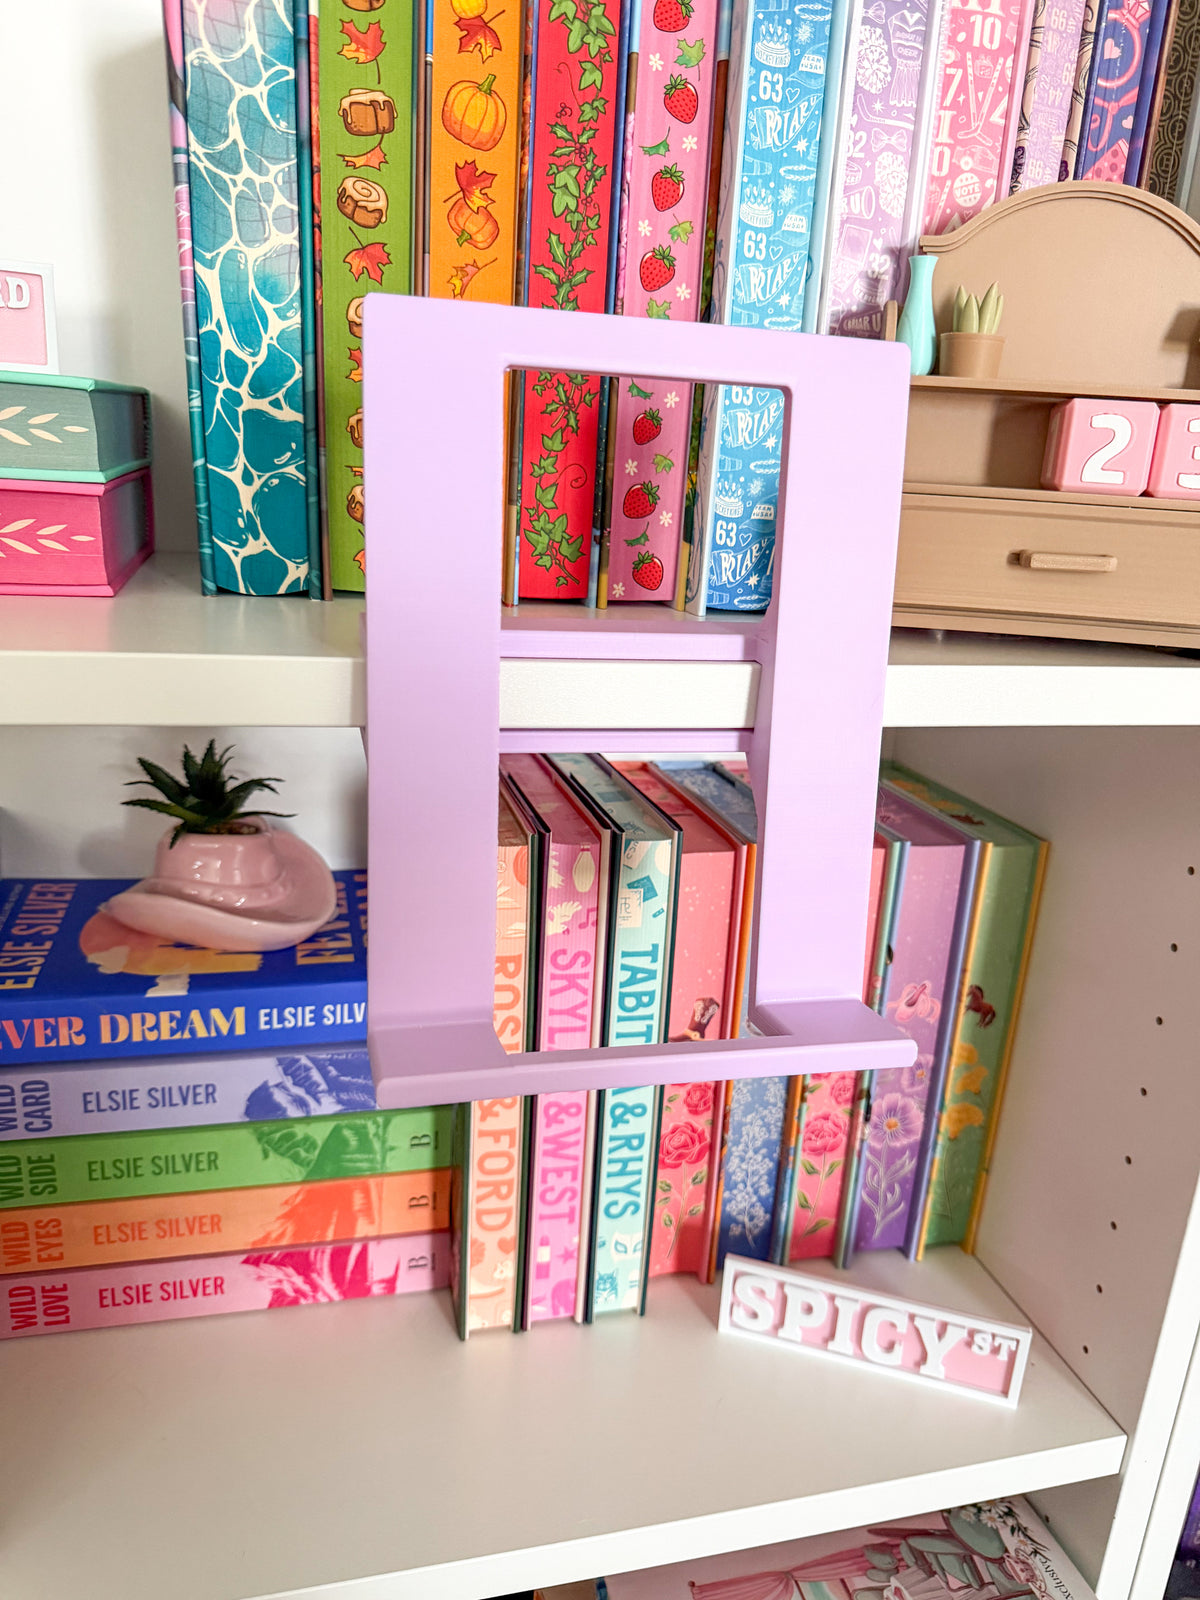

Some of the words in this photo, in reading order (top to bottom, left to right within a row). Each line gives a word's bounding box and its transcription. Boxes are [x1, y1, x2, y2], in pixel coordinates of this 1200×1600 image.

[969, 14, 1001, 50] 10
[759, 70, 783, 103] 63
[764, 101, 809, 146] BRIAR
[955, 183, 980, 198] VOTE
[744, 230, 767, 261] 63
[868, 253, 891, 281] 32
[0, 277, 30, 308] D
[749, 258, 791, 302] BRIAR
[735, 403, 777, 446] BRIAR
[715, 520, 737, 547] 63
[721, 543, 760, 583] BRIAR
[11, 883, 78, 935] SILVER
[0, 940, 53, 989] ELSIE
[547, 948, 592, 1050] SKYL
[615, 942, 660, 1044] TABIT
[0, 1016, 86, 1050] VER
[99, 1006, 247, 1044] DREAM
[258, 1006, 316, 1031] ELSIE
[322, 1002, 367, 1026] SILV
[0, 1084, 18, 1132] WILD
[21, 1079, 53, 1132] CARD
[82, 1088, 140, 1113] ELSIE
[147, 1083, 217, 1108] SILVER
[543, 1101, 582, 1128] &
[609, 1101, 647, 1128] &
[0, 1155, 24, 1201] WILD
[27, 1153, 58, 1196] SIDE
[87, 1157, 144, 1182] ELSIE
[151, 1151, 219, 1176] SILVER
[475, 1127, 517, 1232] FORD
[538, 1126, 582, 1225] WEST
[603, 1132, 646, 1219] RHYS
[1, 1221, 31, 1267] WILD
[34, 1218, 64, 1263] EYES
[93, 1221, 148, 1246] ELSIE
[155, 1214, 222, 1239] SILVER
[8, 1285, 38, 1331] WILD
[41, 1283, 70, 1327] LOVE
[98, 1283, 152, 1309] ELSIE
[159, 1276, 225, 1302] SILVER
[731, 1273, 968, 1379] SPICY
[971, 1331, 1017, 1361] ST
[1040, 1557, 1074, 1600] xclusive
